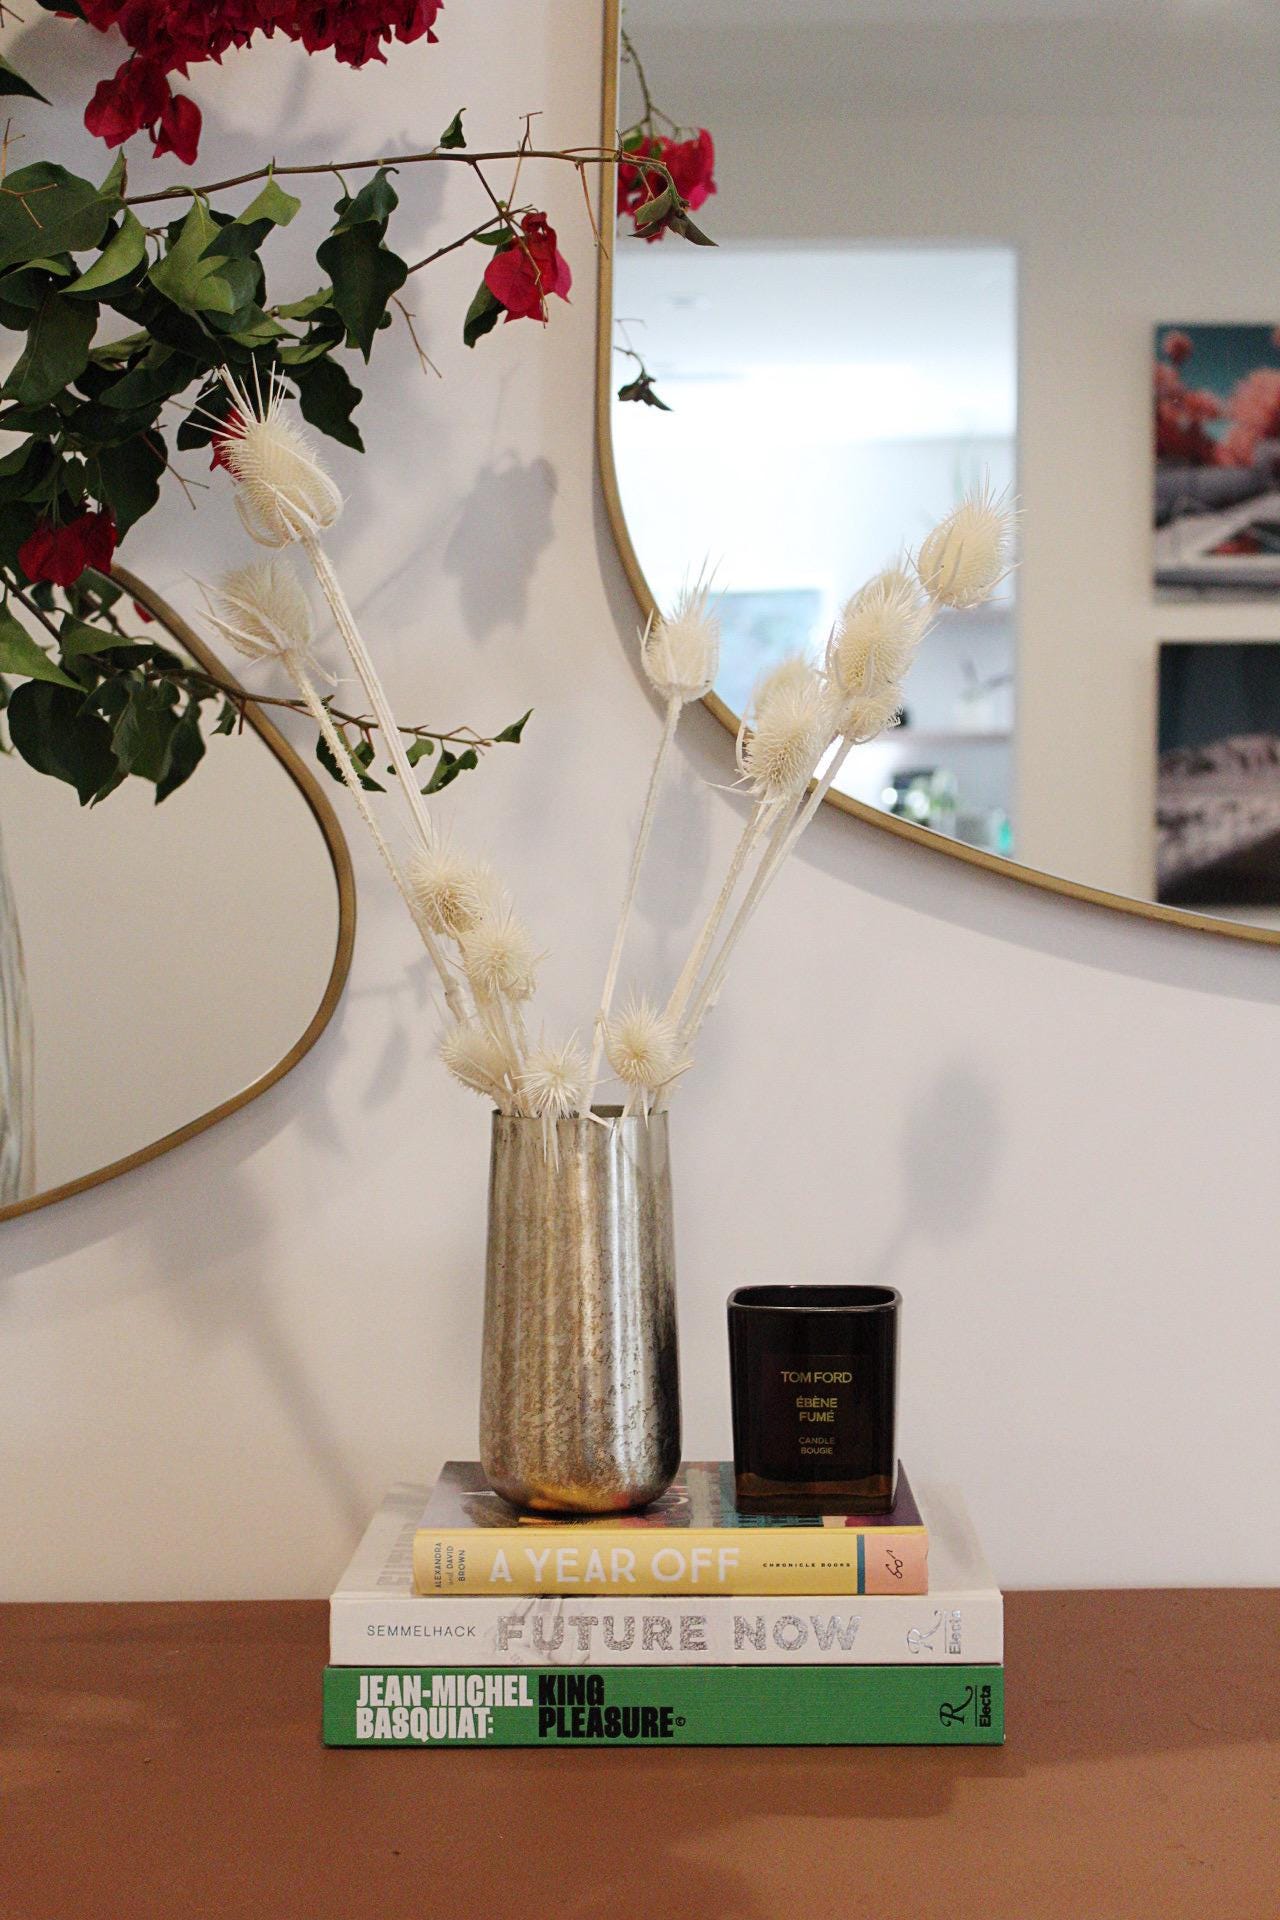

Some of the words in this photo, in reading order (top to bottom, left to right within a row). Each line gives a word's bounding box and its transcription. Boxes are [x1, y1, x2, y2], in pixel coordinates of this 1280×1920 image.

[781, 1371, 812, 1383] TOM
[813, 1371, 853, 1384] FORD
[799, 1410, 835, 1422] FUMÉ
[798, 1436, 835, 1445] CANDLE
[800, 1447, 834, 1455] BOUGIE
[434, 1542, 442, 1588] ALEXANDRA
[446, 1545, 454, 1569] DAVID
[458, 1549, 466, 1582] BROWN
[488, 1548, 513, 1583] A
[524, 1547, 636, 1583] YEAR
[651, 1547, 741, 1583] OFF
[367, 1625, 477, 1637] SEMMELHACK
[497, 1615, 708, 1651] FUTURE
[733, 1615, 864, 1651] NOW
[949, 1609, 961, 1655] Electa
[356, 1675, 534, 1707] JEAN-MICHEL
[538, 1675, 605, 1706] KING
[979, 1685, 991, 1727] Electa
[356, 1706, 494, 1743] BASQUIAT:
